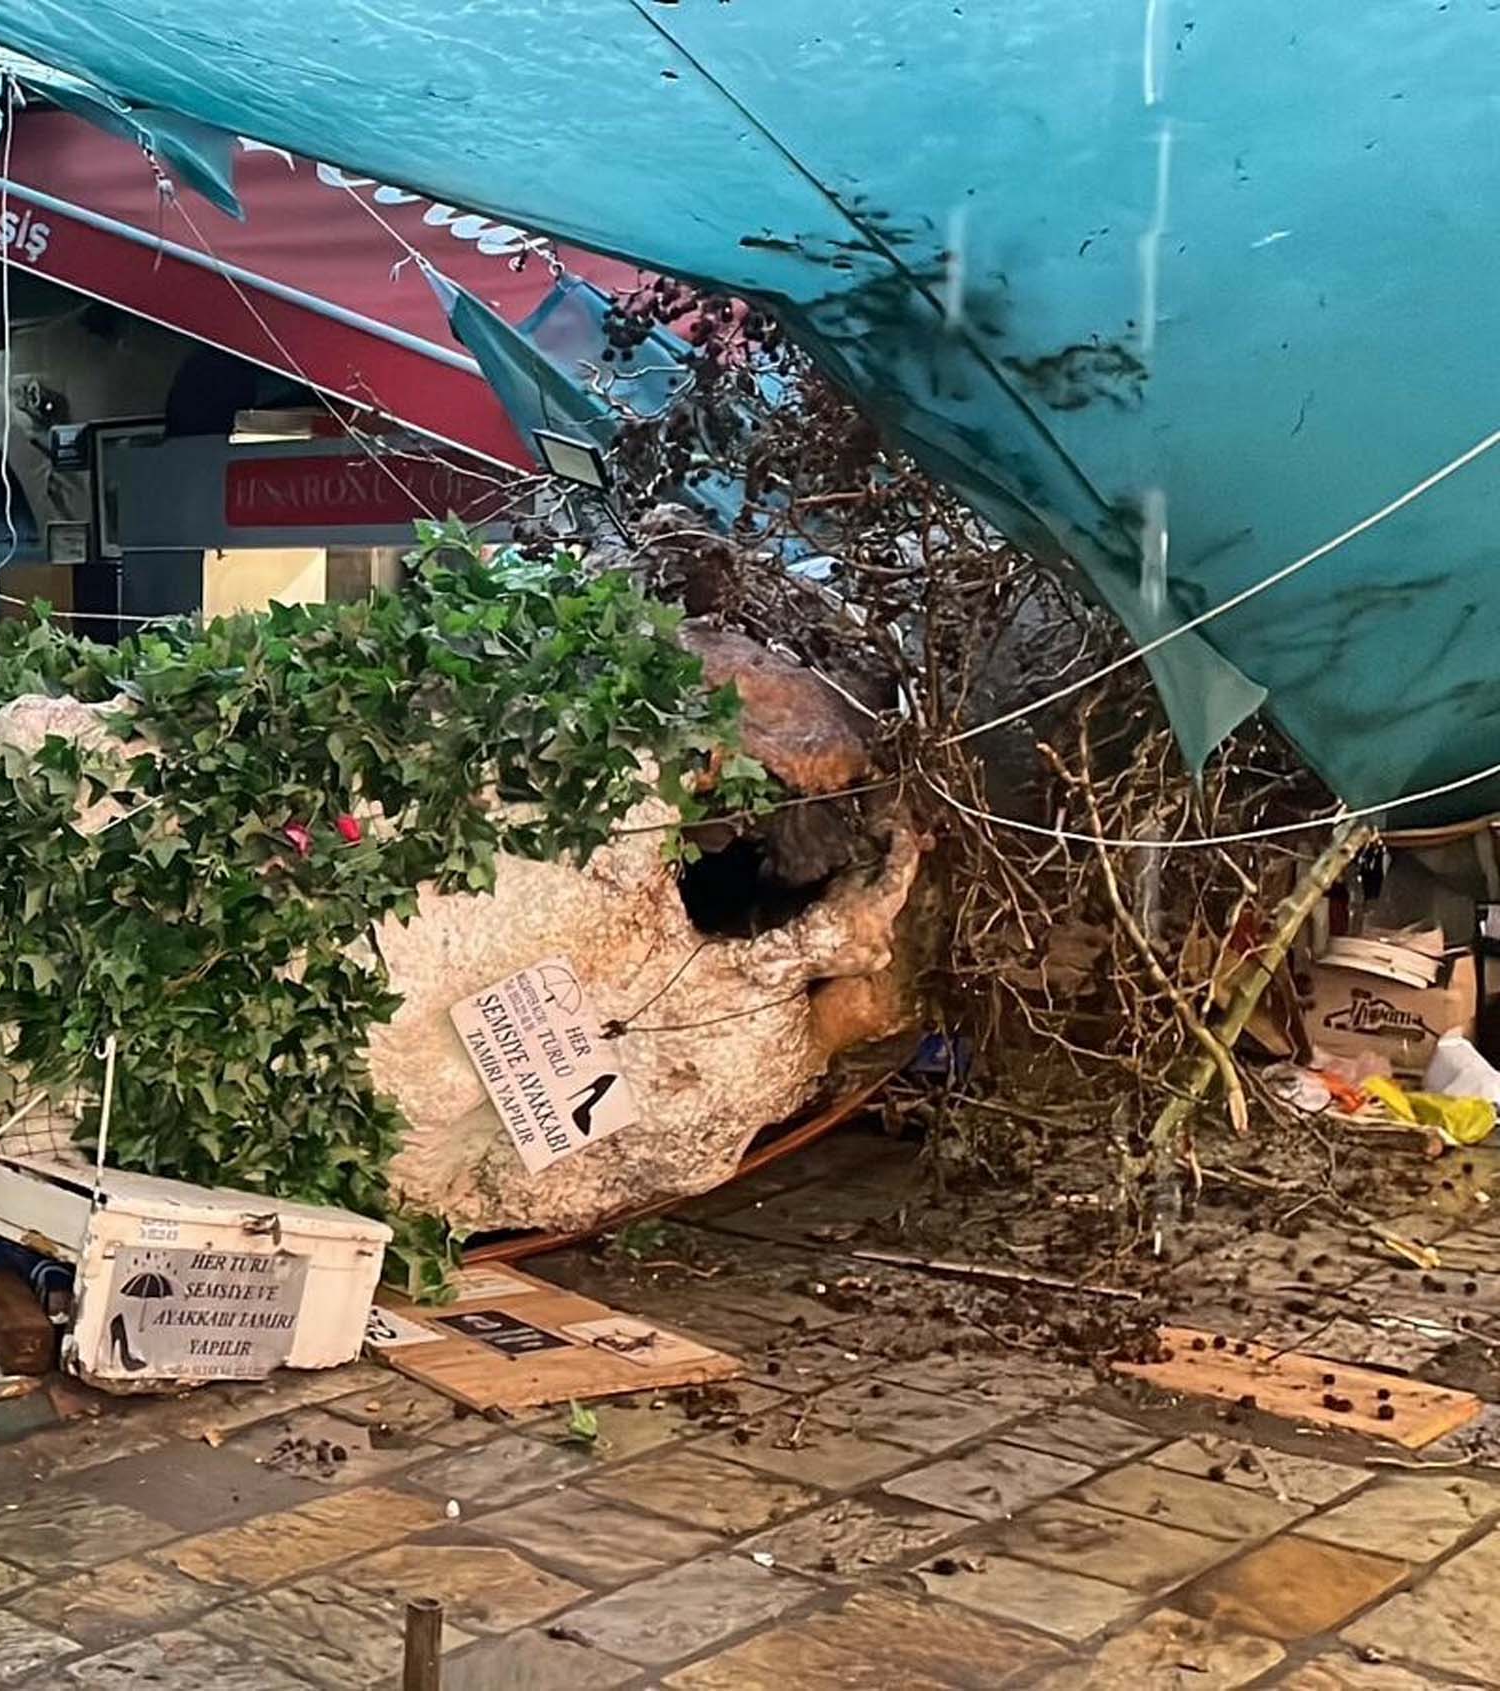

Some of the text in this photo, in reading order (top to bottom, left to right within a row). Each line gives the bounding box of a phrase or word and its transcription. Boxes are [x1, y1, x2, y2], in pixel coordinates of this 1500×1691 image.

[565, 1025, 593, 1057] HER
[496, 1083, 536, 1146] YAPILIR
[515, 1072, 571, 1154] AYAKKABI
[190, 1253, 227, 1272] HER
[152, 1309, 236, 1328] AYAKKABI
[187, 1339, 253, 1356] YAPILIR
